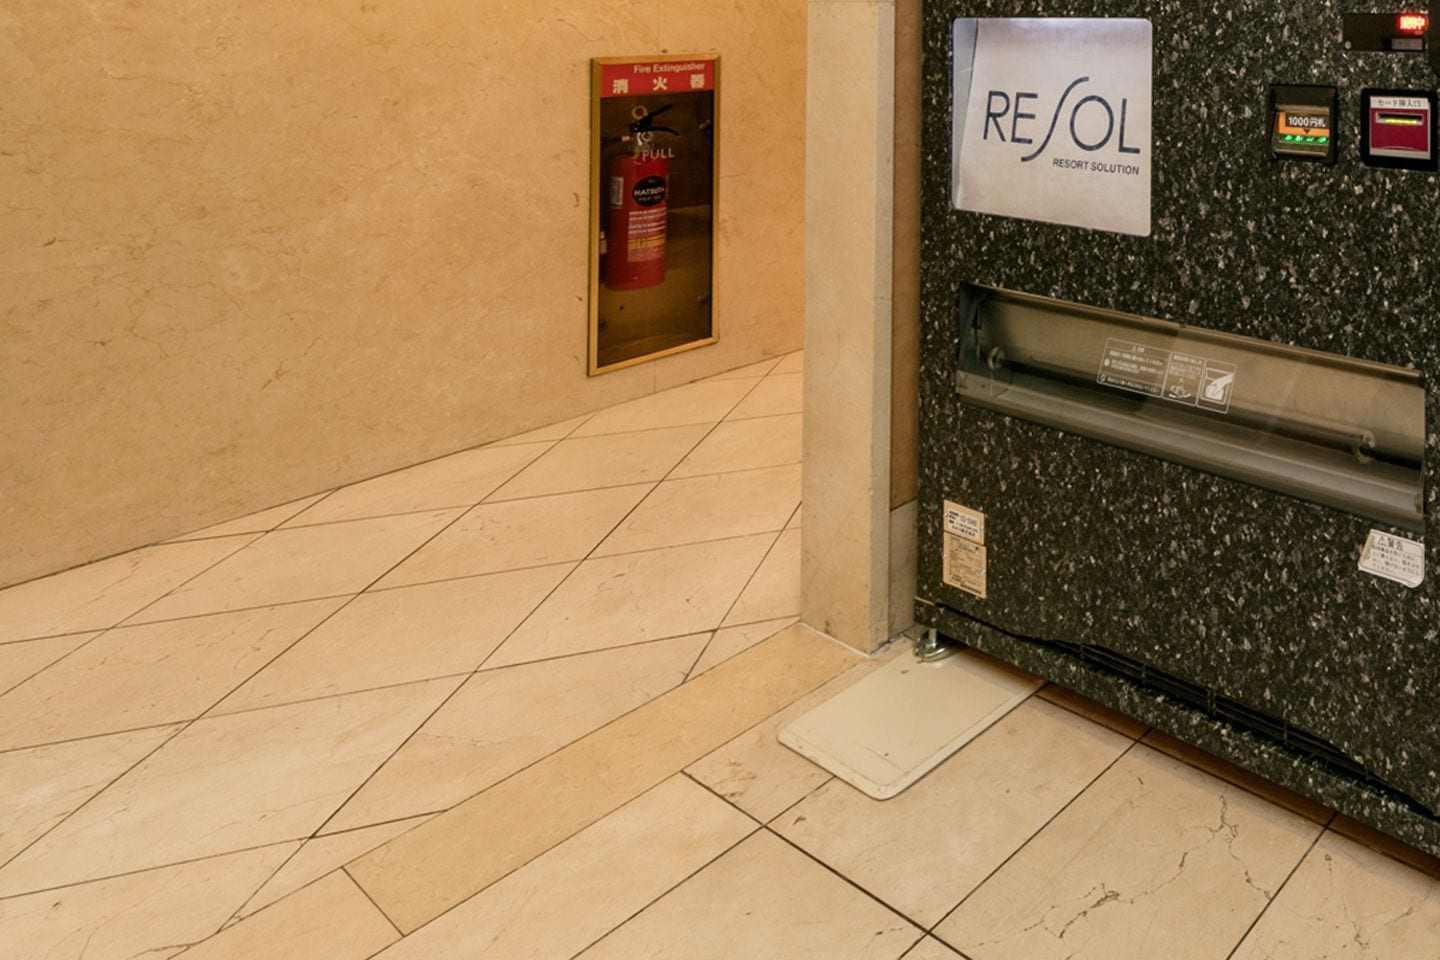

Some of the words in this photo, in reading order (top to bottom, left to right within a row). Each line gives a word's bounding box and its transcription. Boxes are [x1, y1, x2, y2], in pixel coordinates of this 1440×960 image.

[633, 64, 651, 74] Fire
[652, 62, 705, 74] Extinguisher
[983, 76, 1141, 162] RESOL
[1288, 116, 1327, 128] 1000円札
[642, 148, 675, 162] PULL
[1052, 158, 1088, 171] RESORT
[1091, 161, 1140, 175] SOLUTION
